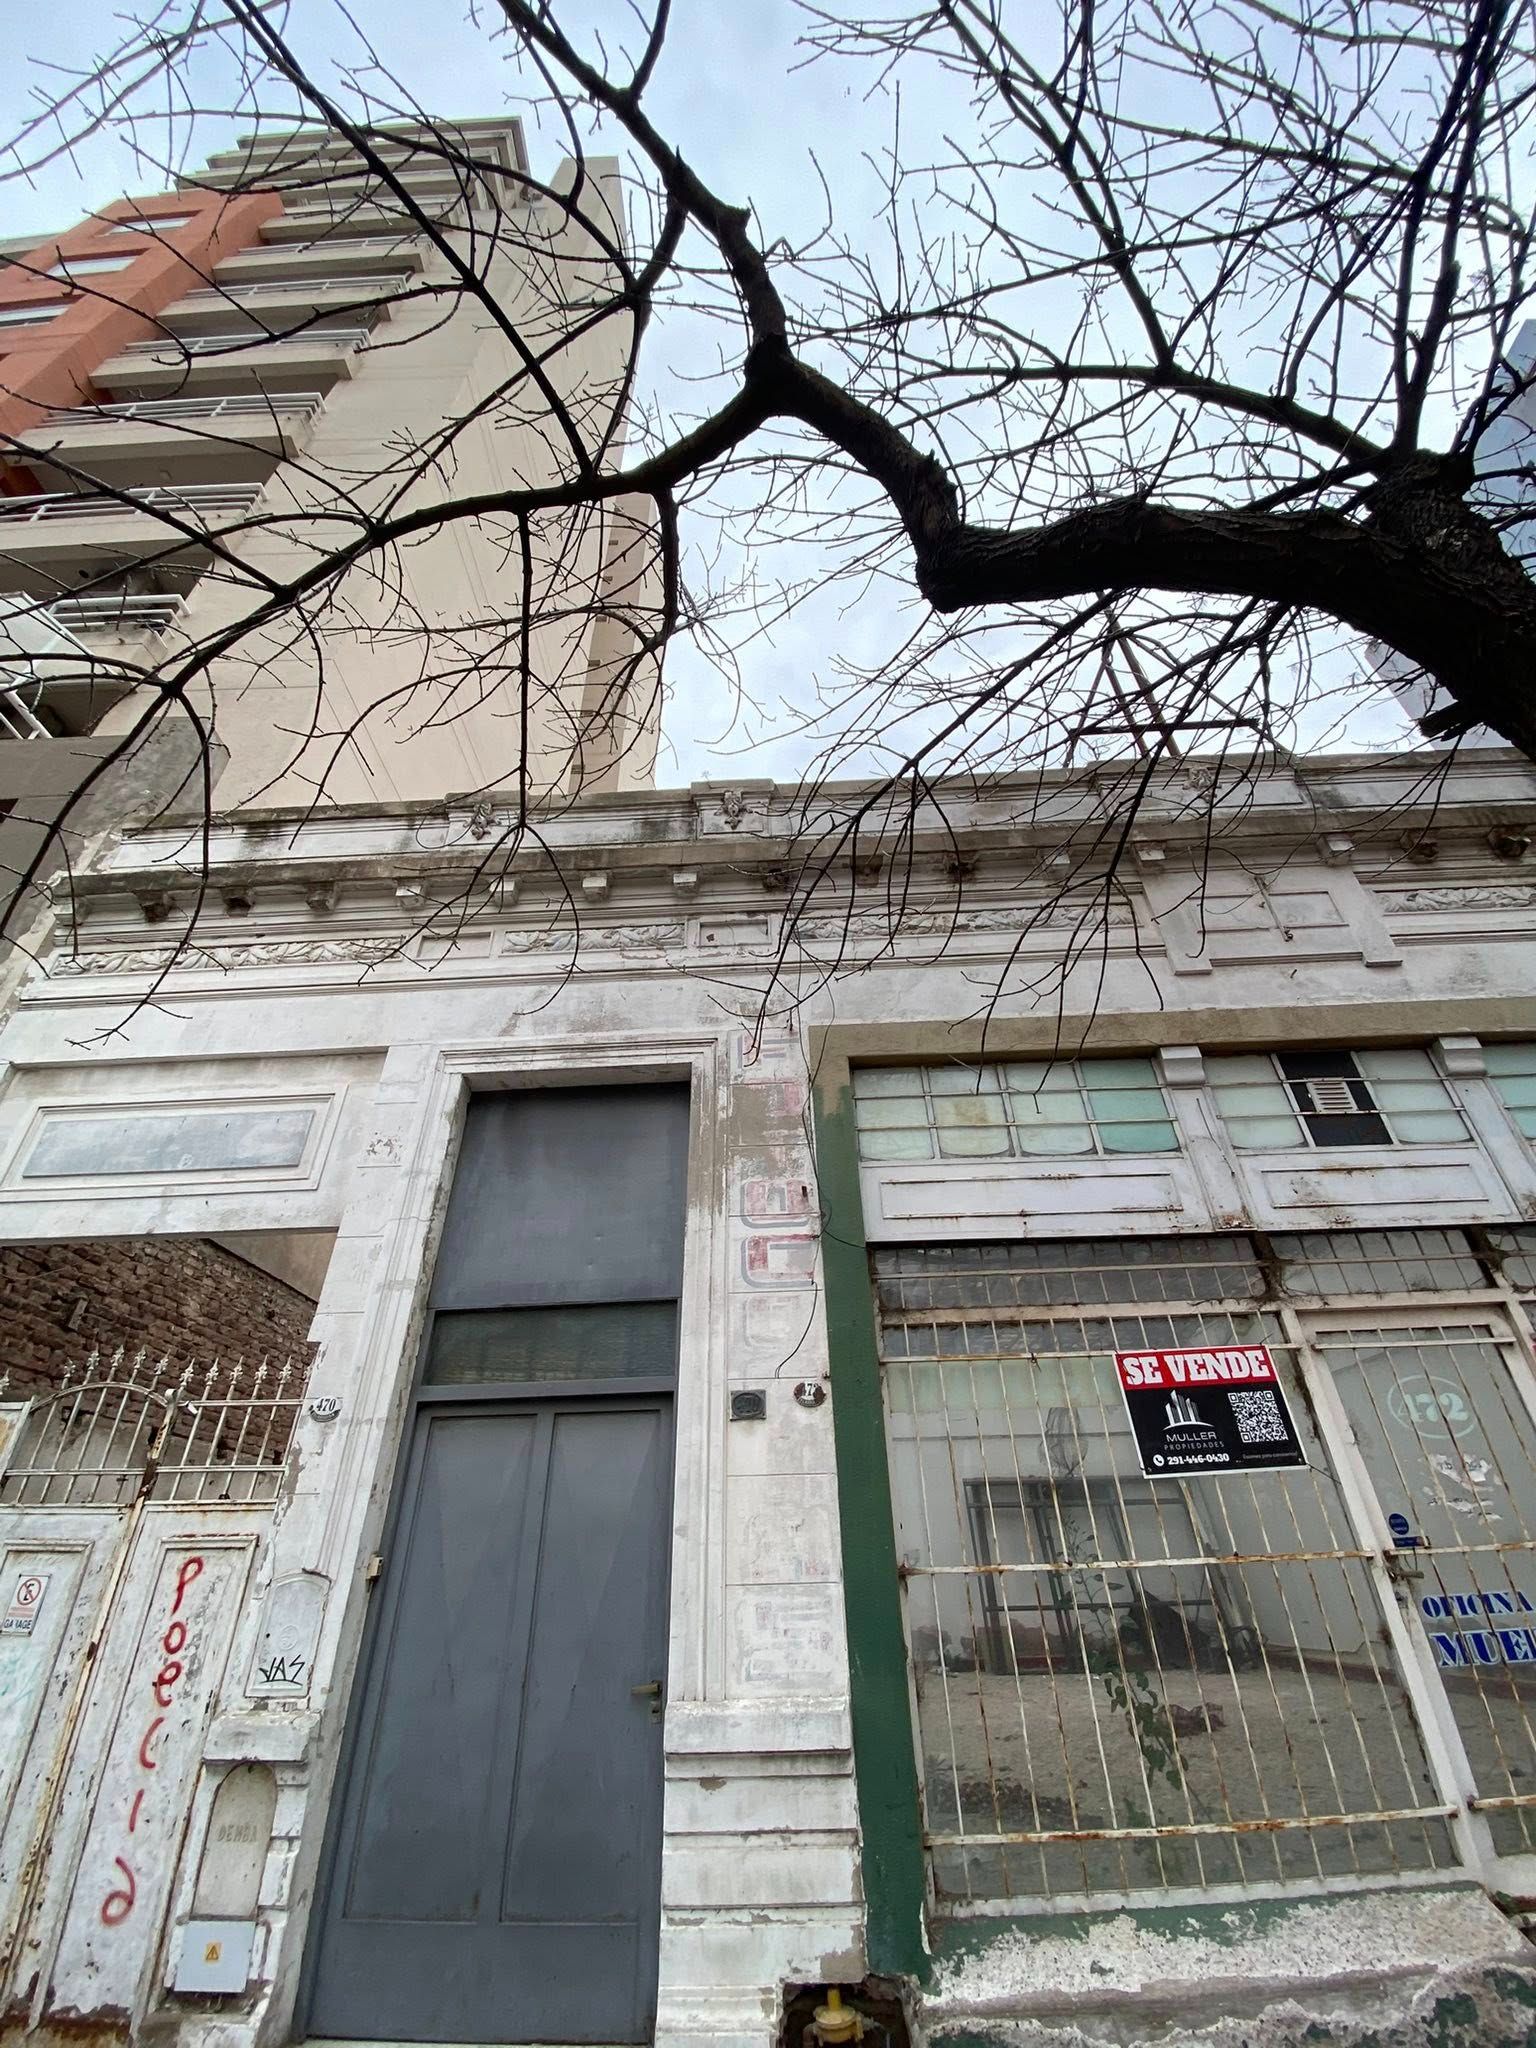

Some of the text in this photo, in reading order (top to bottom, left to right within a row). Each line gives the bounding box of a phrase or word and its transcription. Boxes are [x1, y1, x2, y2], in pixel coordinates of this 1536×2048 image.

[1123, 1350, 1271, 1386] SE VENDE
[316, 1398, 337, 1412] 470
[1397, 1392, 1470, 1422] 472
[1166, 1432, 1217, 1442] MULLER
[1164, 1441, 1225, 1451] PROPIEDADES
[1167, 1453, 1230, 1465] 291-446-0430
[1421, 1589, 1534, 1618] OFICINA
